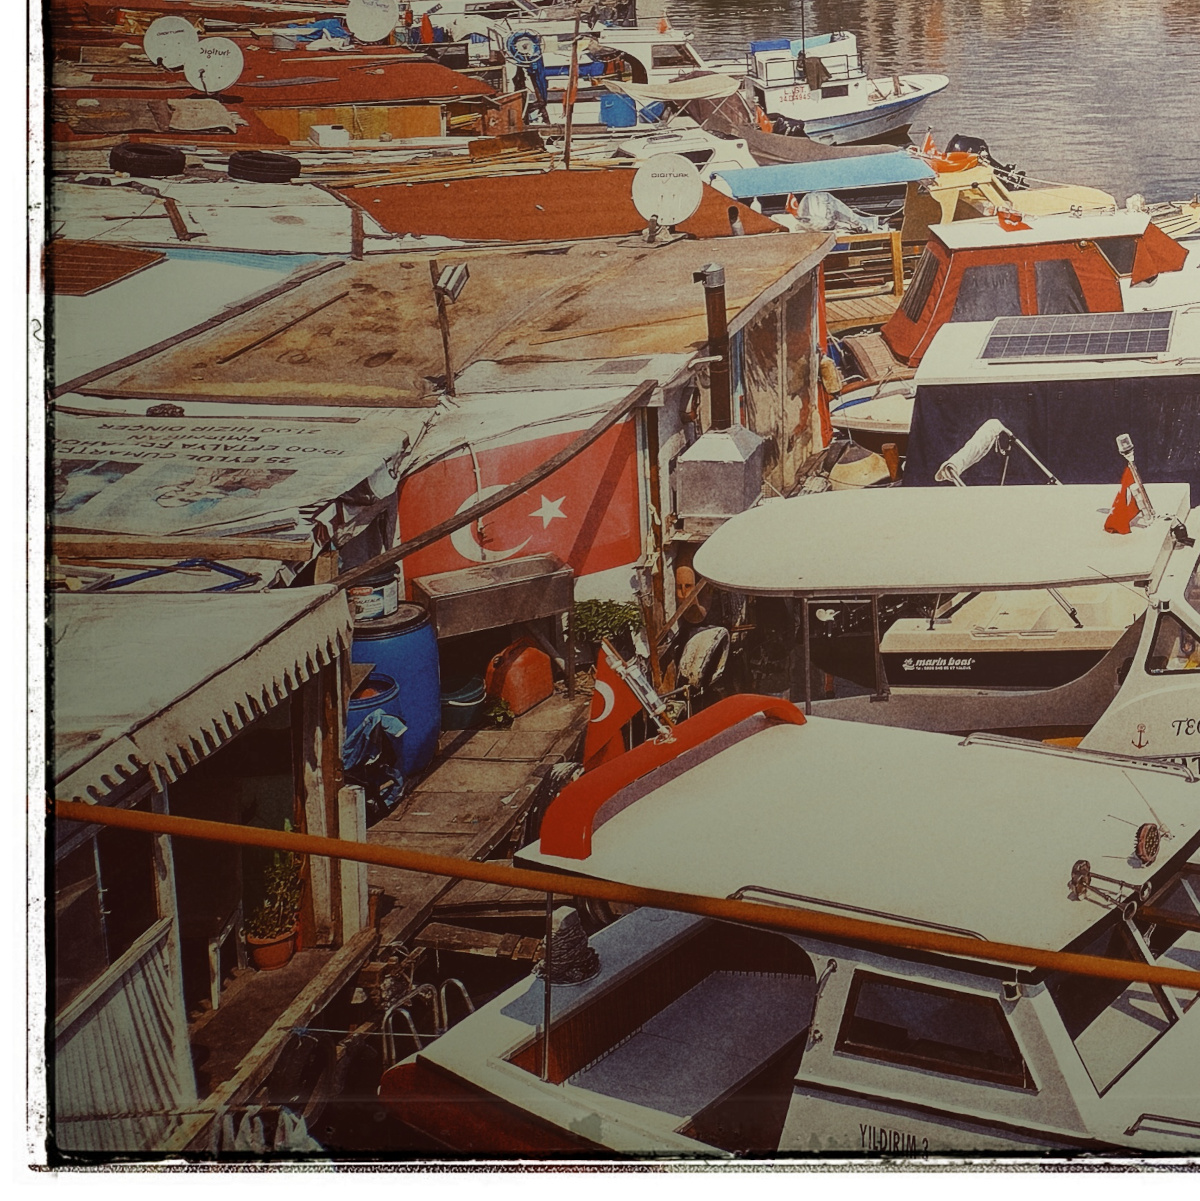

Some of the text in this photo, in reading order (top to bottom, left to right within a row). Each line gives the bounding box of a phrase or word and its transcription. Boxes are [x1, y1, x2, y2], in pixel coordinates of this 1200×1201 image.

[181, 442, 280, 452] EFTALYA
[285, 445, 345, 456] 19:00
[263, 456, 296, 464] 25
[915, 657, 973, 666] marin boat
[859, 1123, 917, 1159] YILDIRIM
